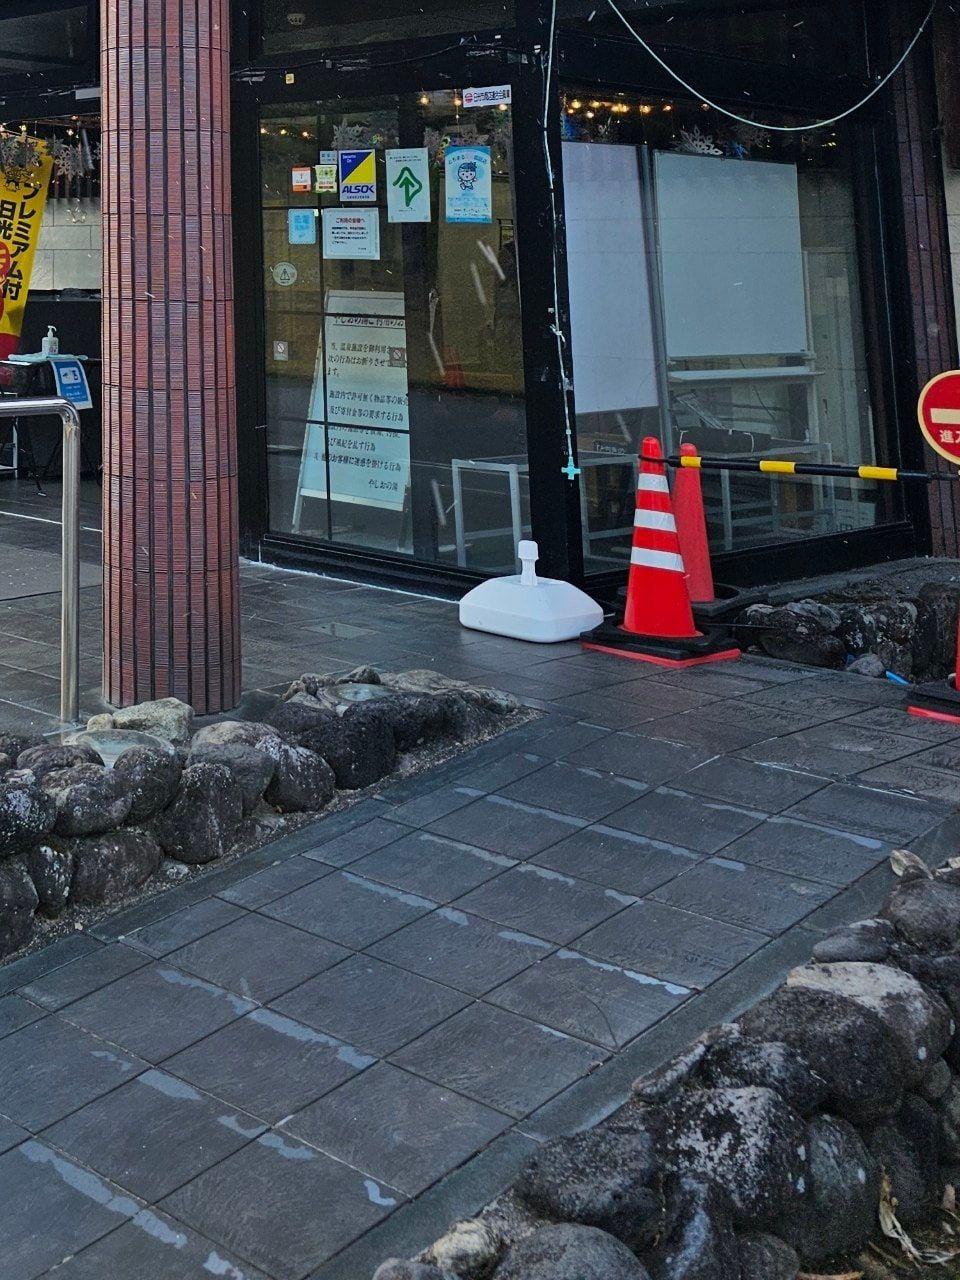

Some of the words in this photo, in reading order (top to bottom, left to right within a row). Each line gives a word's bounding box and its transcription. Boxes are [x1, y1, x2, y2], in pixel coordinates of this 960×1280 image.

[342, 185, 375, 194] ALSOK
[1, 181, 42, 300] プレミアム付
